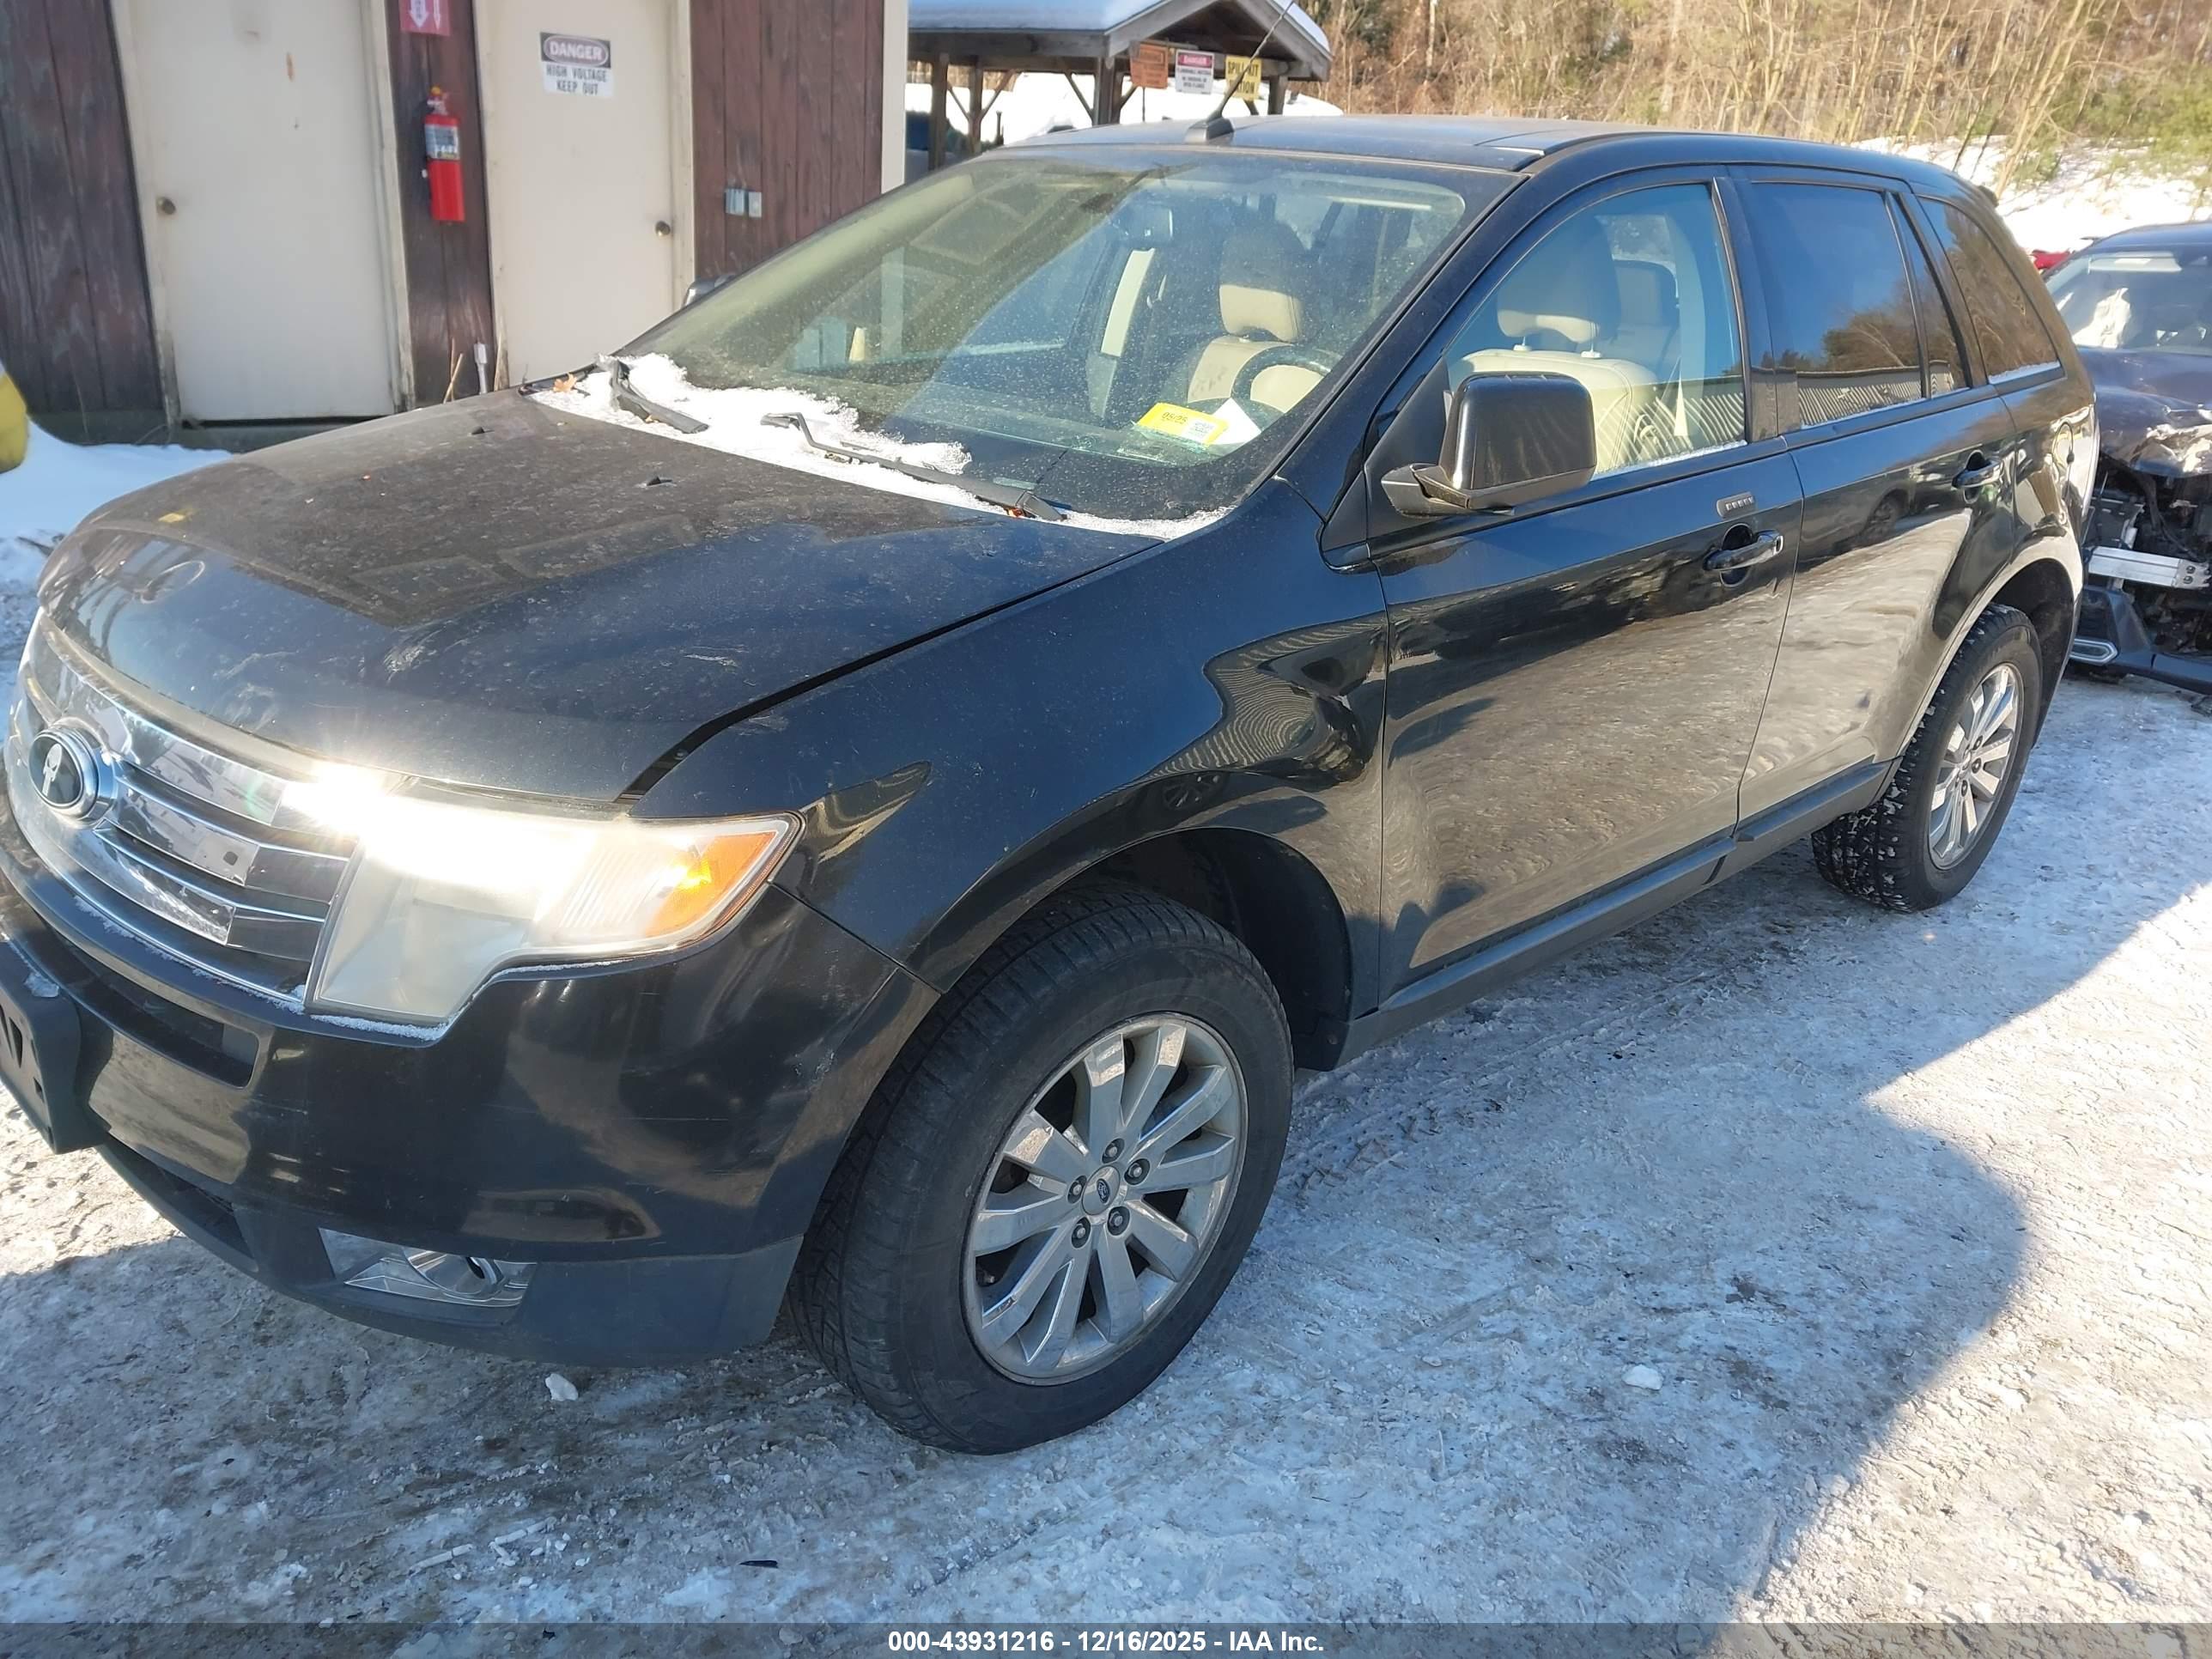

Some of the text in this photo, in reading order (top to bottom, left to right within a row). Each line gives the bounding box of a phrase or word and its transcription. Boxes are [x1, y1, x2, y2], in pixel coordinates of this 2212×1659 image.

[550, 40, 602, 61] DANGER
[546, 64, 607, 82] HIGH VOLTAGE
[556, 80, 599, 96] KEEP OUT
